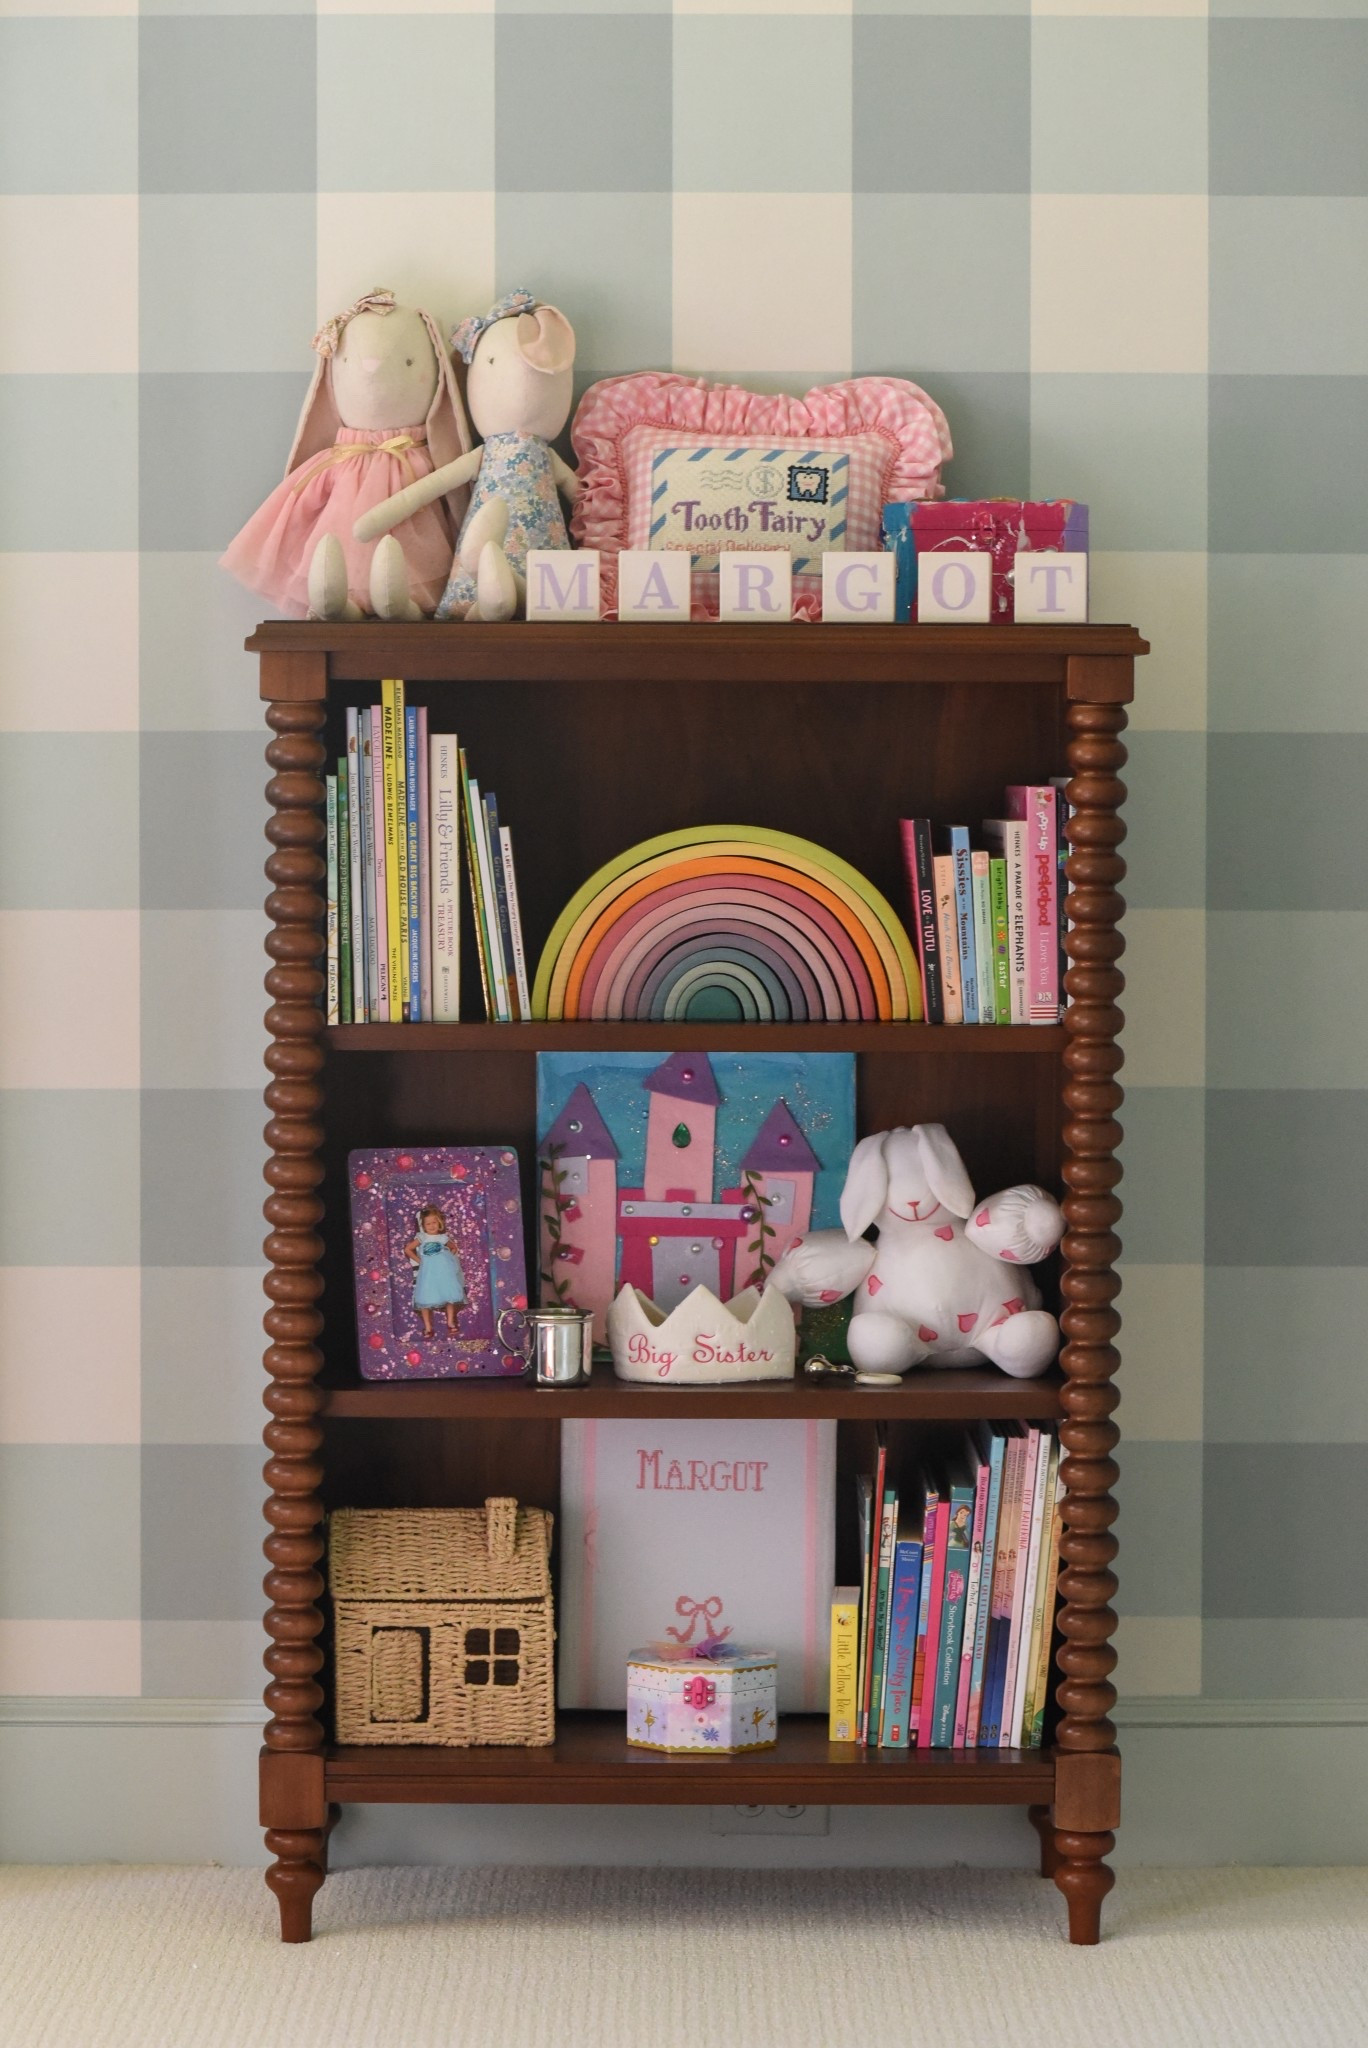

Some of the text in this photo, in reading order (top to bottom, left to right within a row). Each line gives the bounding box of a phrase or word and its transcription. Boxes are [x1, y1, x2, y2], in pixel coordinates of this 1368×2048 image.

[671, 500, 826, 542] Tooth Fairy
[384, 707, 393, 759] MADELINE
[340, 821, 348, 865] Christmas
[435, 790, 453, 894] Lilly & Friends
[340, 867, 348, 875] of
[996, 867, 1004, 890] bright
[1035, 855, 1052, 926] peekaboo!
[494, 857, 508, 933] Give Me Grace
[921, 889, 933, 916] LOVE
[956, 849, 969, 960] Sissies Mountains
[1016, 902, 1022, 912] OF
[341, 929, 349, 945] The
[924, 924, 935, 951] TUTU
[1015, 915, 1024, 972] ELEPHANTS
[1040, 940, 1049, 963] Love
[1040, 967, 1049, 985] You
[628, 1333, 774, 1377] Big Sister
[636, 1449, 769, 1492] MARGOT
[978, 1585, 988, 1632] QUITTING
[888, 1645, 911, 1687] Stinky
[943, 1605, 957, 1685] Storybook Collection
[836, 1634, 852, 1714] Little Yellow Bee
[872, 1675, 881, 1708] Eastman
[890, 1690, 906, 1714] Face
[940, 1704, 951, 1723] Disney
